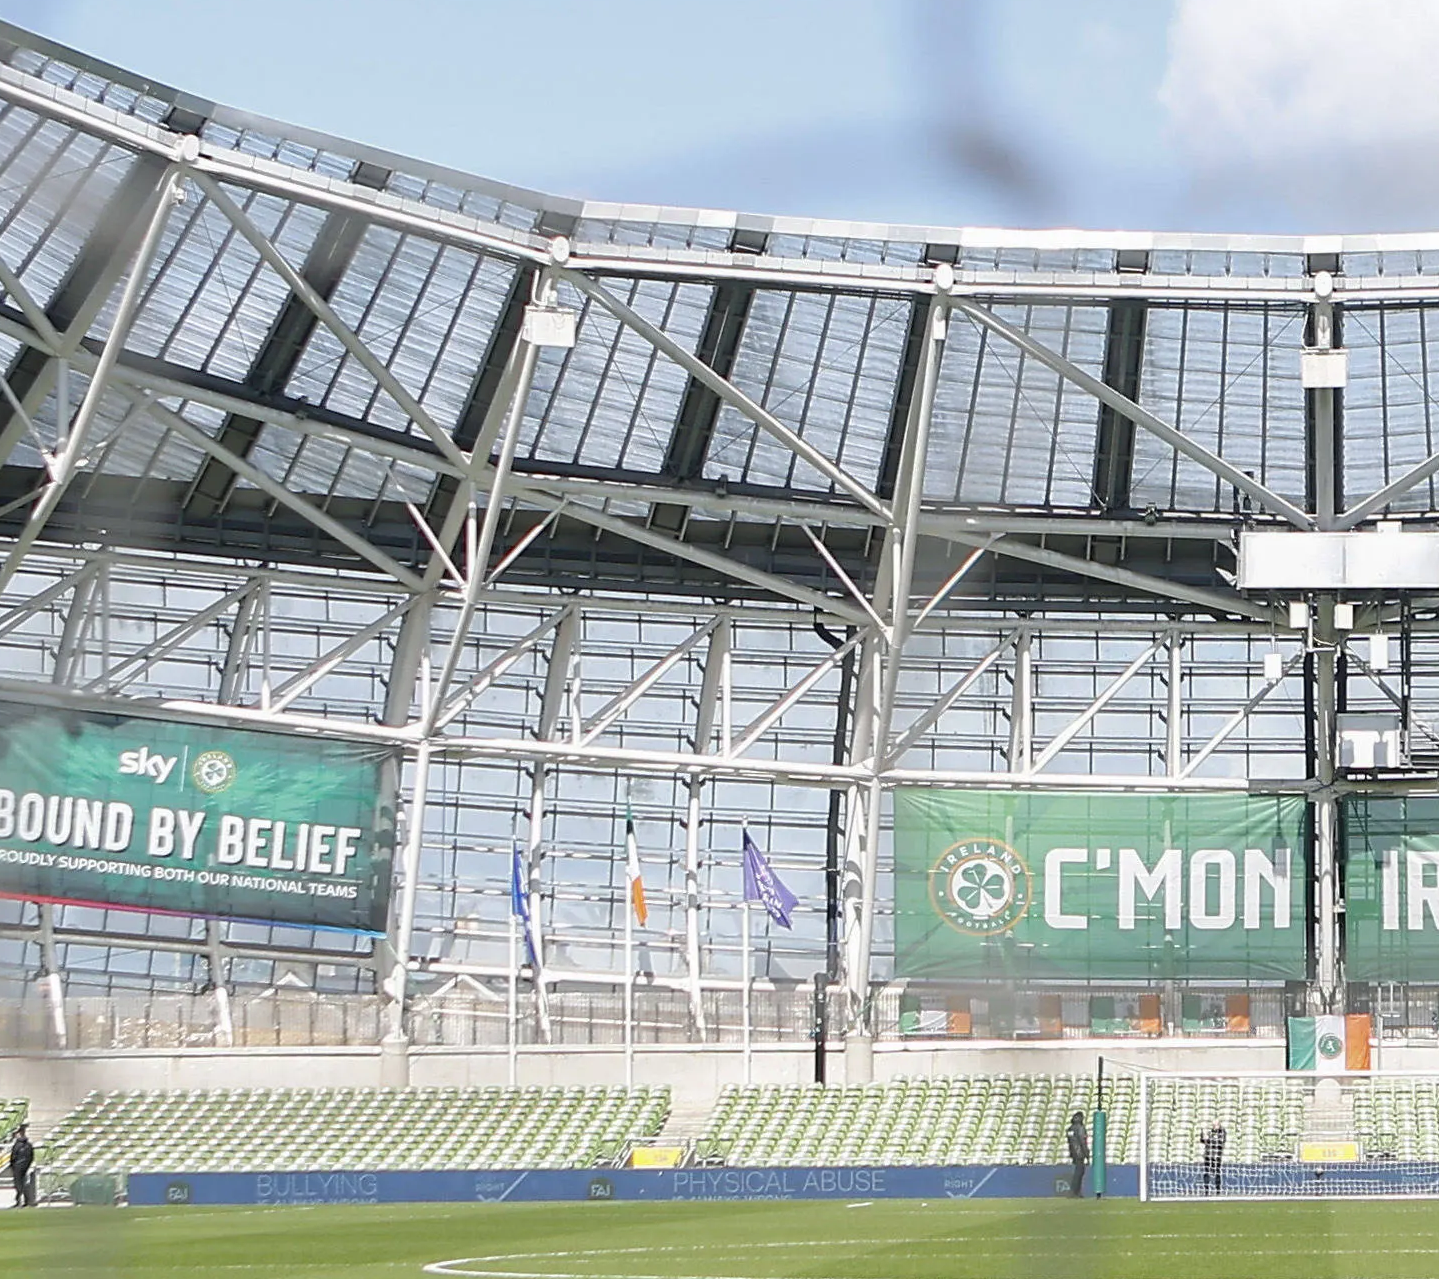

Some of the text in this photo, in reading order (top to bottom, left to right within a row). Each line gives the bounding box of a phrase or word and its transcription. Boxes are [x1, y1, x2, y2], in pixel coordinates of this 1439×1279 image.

[118, 746, 178, 784] sky
[148, 807, 207, 860] BY
[218, 815, 362, 875] BELIEF
[940, 843, 1022, 875] IRELAND
[58, 856, 152, 878] SUPPORTING
[154, 867, 195, 883] BOTH
[198, 872, 230, 887] OUR
[232, 875, 307, 895] NATIONAL
[308, 882, 358, 899] TEAMS
[1043, 847, 1292, 930] C'MON
[257, 1174, 378, 1197] BULLYING
[673, 1170, 886, 1193] PHYSICAL ABUSE
